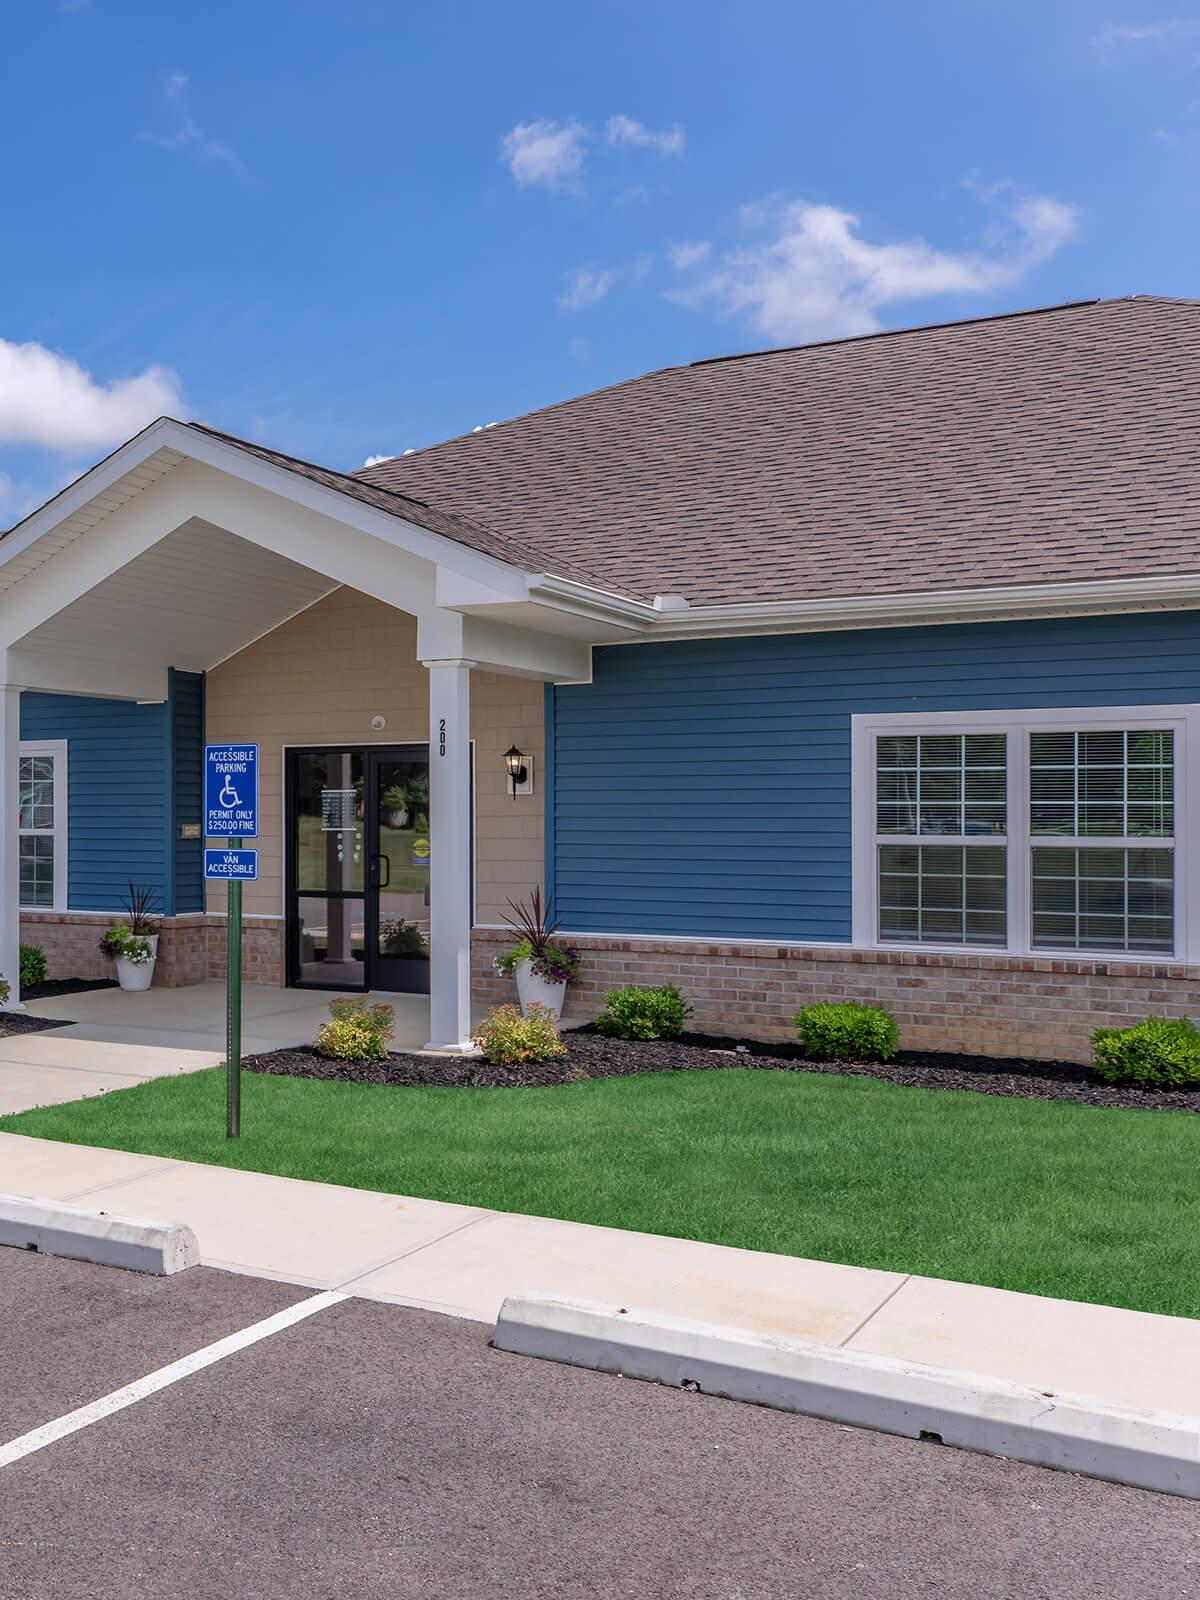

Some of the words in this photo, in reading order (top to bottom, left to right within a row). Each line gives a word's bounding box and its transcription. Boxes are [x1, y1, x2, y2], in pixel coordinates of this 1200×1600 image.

[208, 751, 254, 762] ACCESSIBLE
[215, 763, 247, 773] PARKING
[209, 810, 233, 820] PERMIT
[236, 810, 253, 819] ONLY
[208, 820, 238, 830] $250.00
[239, 821, 254, 830] FINE
[223, 855, 239, 864] VAN
[207, 864, 254, 874] ACCESSIBLE
